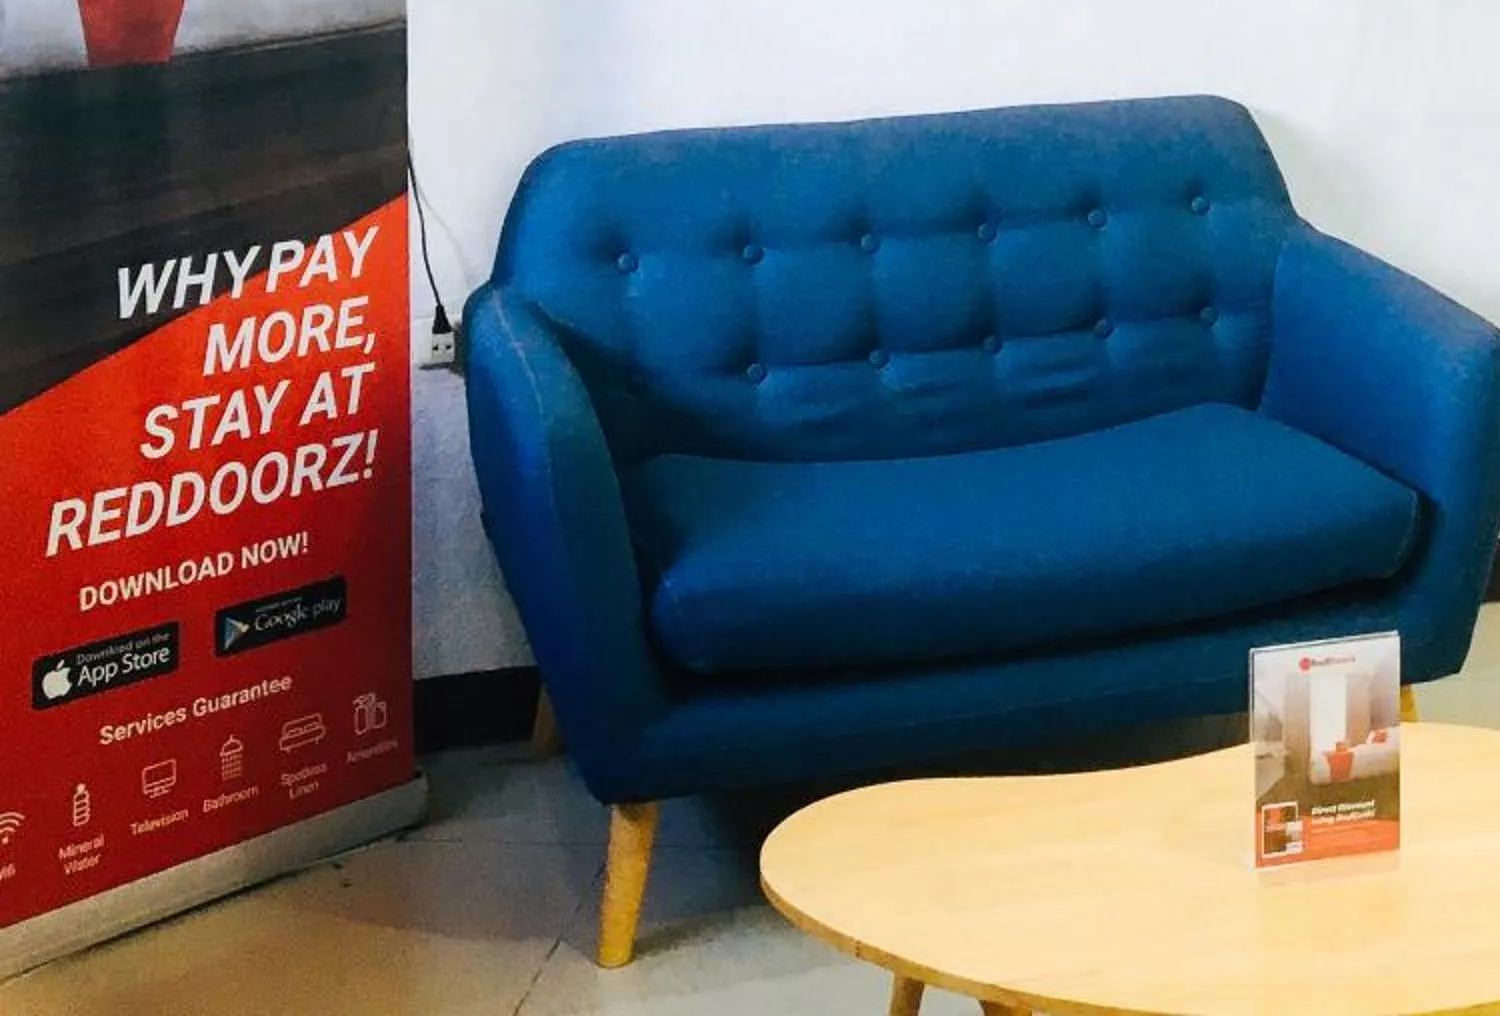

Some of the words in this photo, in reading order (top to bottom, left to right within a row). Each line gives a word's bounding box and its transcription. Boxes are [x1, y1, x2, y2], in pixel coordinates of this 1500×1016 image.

[116, 245, 262, 320] WHY
[265, 225, 380, 294] PAY
[202, 295, 376, 377] MORE,
[139, 379, 291, 460] STAY
[299, 362, 376, 426] AT
[44, 429, 380, 558] REDDOORZ!
[79, 551, 235, 613] DOWNLOAD
[240, 530, 310, 571] NOW!
[254, 603, 309, 632] Google
[76, 661, 119, 688] App
[121, 646, 171, 675] Store
[99, 706, 187, 746] Services
[192, 675, 293, 718] Guarantee
[130, 808, 190, 836] Television
[203, 784, 260, 814] Bathroom
[58, 833, 105, 862] Mineral
